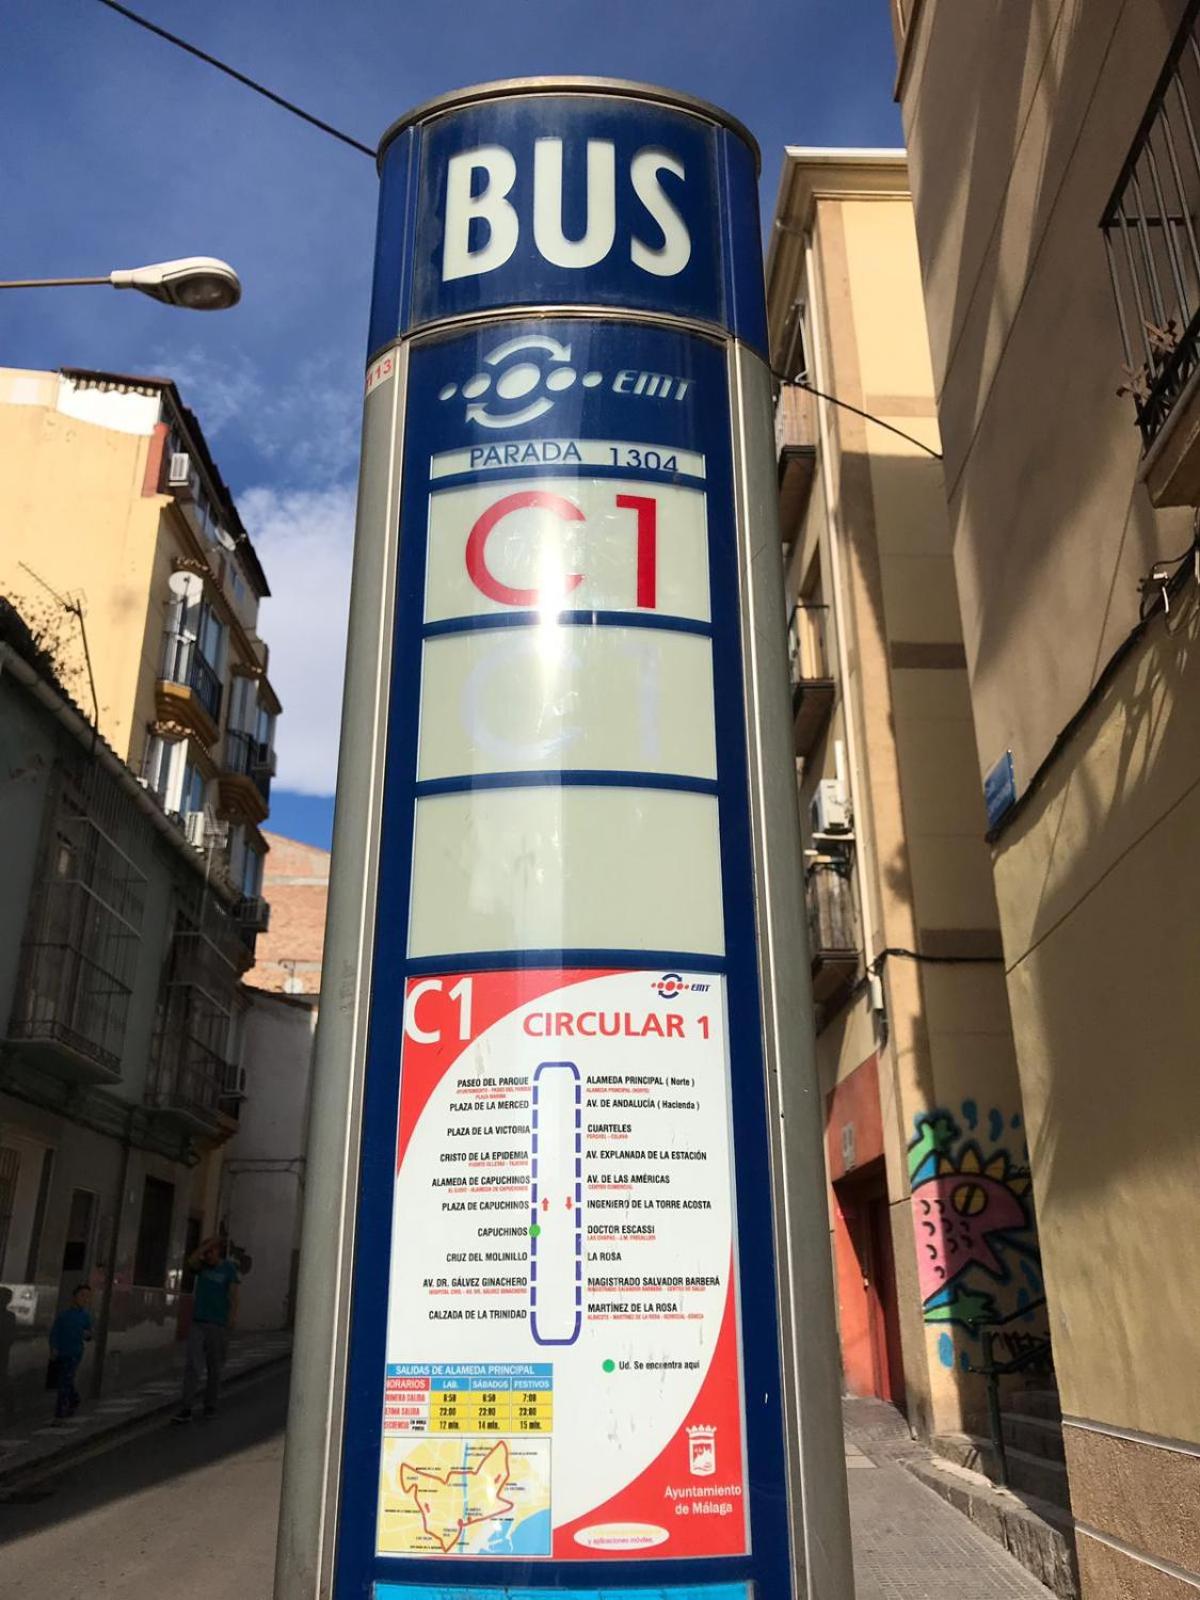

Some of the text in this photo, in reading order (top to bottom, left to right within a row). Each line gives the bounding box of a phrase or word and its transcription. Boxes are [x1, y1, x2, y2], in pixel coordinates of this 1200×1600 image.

[442, 136, 692, 281] BUS
[470, 442, 679, 472] PARADA 1304
[465, 490, 656, 609] C1
[404, 977, 472, 1044] C1
[523, 1012, 709, 1039] CIRCULAR 1
[457, 1077, 529, 1088] PASEO DEL PARQUE
[586, 1076, 623, 1084] ALAMEDA
[625, 1076, 664, 1085] PRINCIPAL
[449, 1100, 529, 1112] PLAZA DE LA MERCED
[586, 1099, 598, 1108] AV.
[600, 1100, 611, 1108] DE
[612, 1098, 655, 1108] ANDALUCÍA
[662, 1101, 695, 1109] Hacienda
[447, 1125, 530, 1136] PLAZA DE LA VICTORIA
[587, 1124, 632, 1133] CUARTELES
[440, 1150, 528, 1162] CRISTO DE LA EPIDEMIA
[586, 1149, 707, 1160] AV. EXPLANADA DE LA ESTACIÓN
[432, 1175, 530, 1187] ALAMEDA DE CAPUCHINOS
[587, 1173, 671, 1184] AV. DE LAS AMÉRICAS
[442, 1200, 529, 1211] PLAZA DE CAPUCHINOS
[587, 1200, 712, 1210] INGENIERO DE LA TORRE ACOSTA
[477, 1227, 528, 1237] CAPUCHINOS
[587, 1225, 655, 1234] DOCTOR ESCASSI
[446, 1252, 528, 1262] CRUZ DEL MOLINILLO
[587, 1252, 622, 1261] LA ROSA
[423, 1276, 528, 1287] AV. DR. GÁLVEZ GINACHERO
[588, 1275, 720, 1286] MAGISTRADO SALVADOR BARBERÁ
[588, 1301, 678, 1312] MARTÍNEZ DE LA ROSA
[429, 1310, 527, 1320] CALZADA DE LA TRINIDAD
[395, 1365, 535, 1375] SALIDAS DE ALAMEDA PRINCIPAL
[619, 1361, 632, 1370] Ud.
[634, 1361, 644, 1370] Se
[665, 1485, 742, 1499] Ayuntamiento
[675, 1501, 733, 1515] de Málaga
